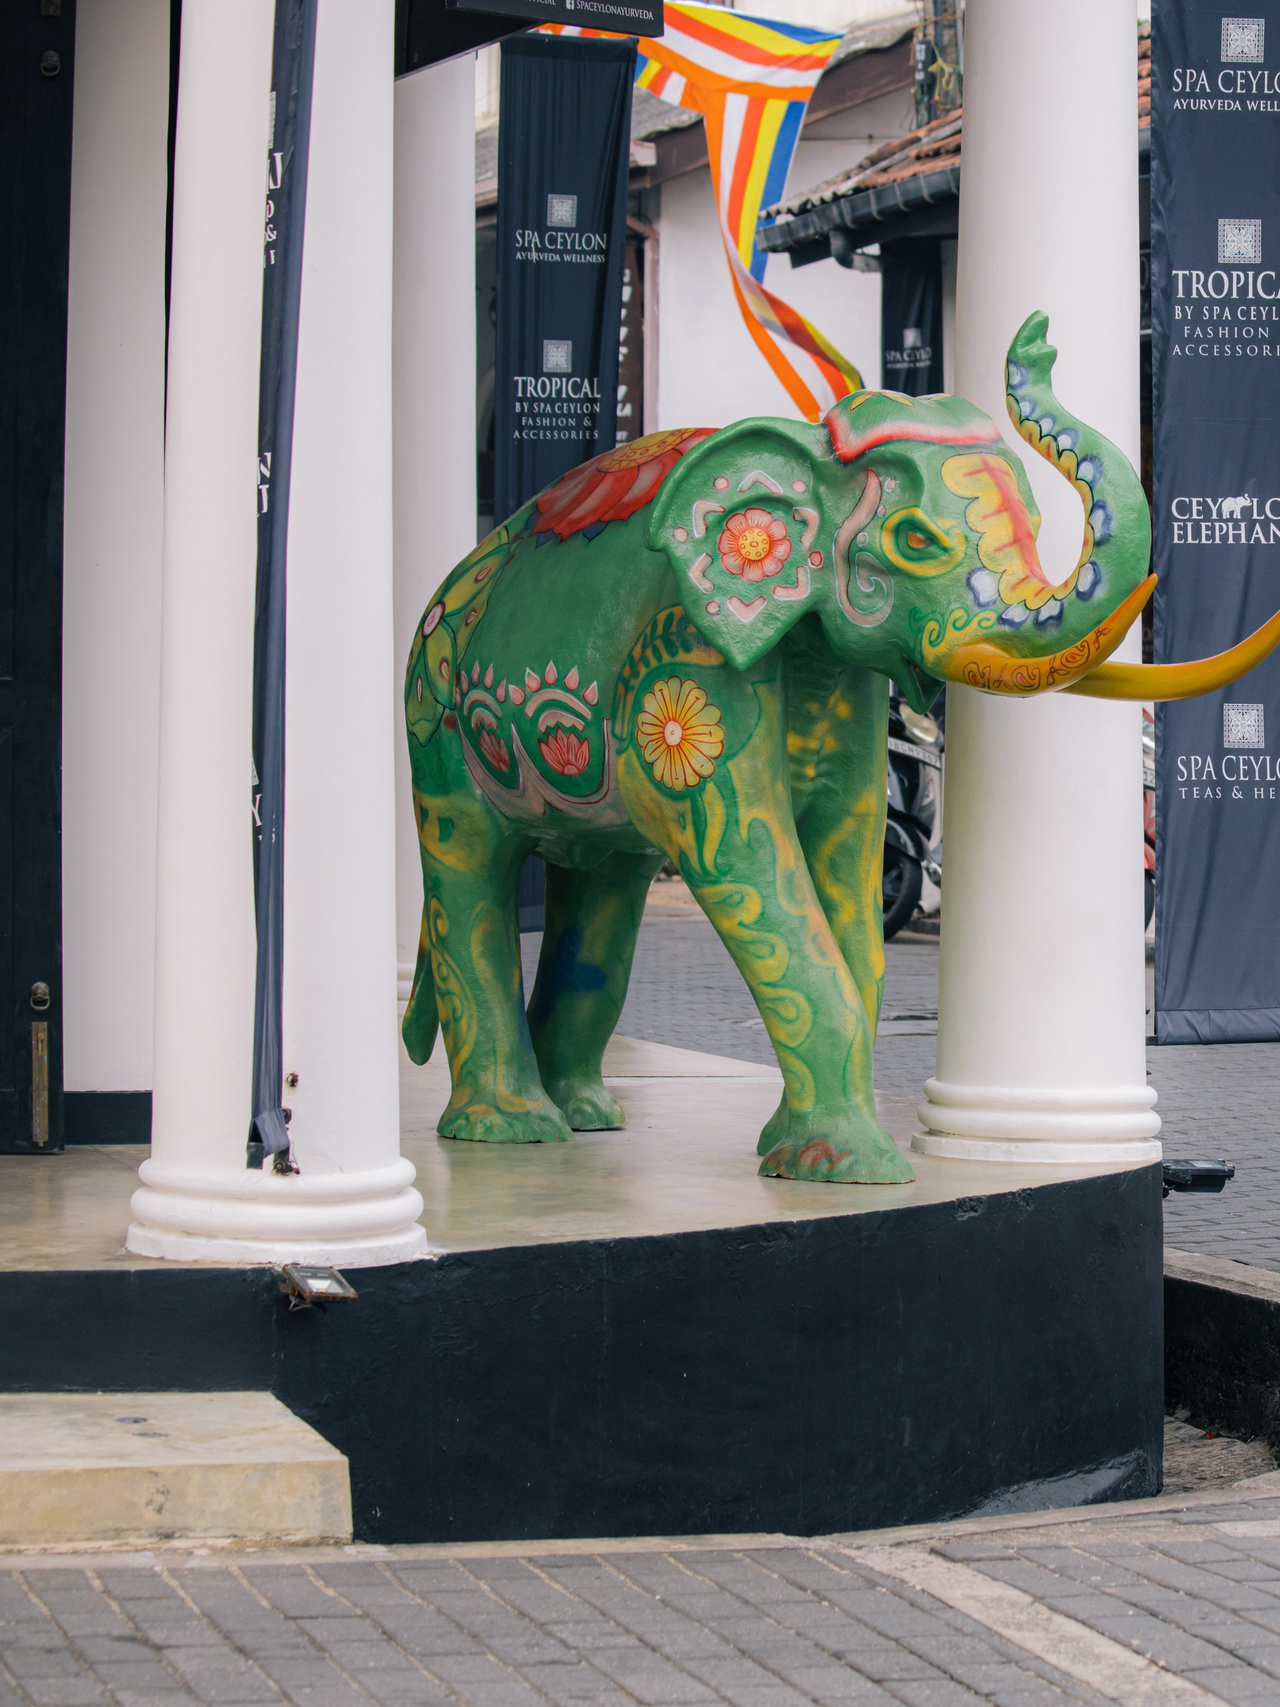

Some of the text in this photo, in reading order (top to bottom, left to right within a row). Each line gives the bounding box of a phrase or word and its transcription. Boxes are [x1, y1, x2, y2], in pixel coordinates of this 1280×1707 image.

[576, 0, 654, 20] SPACEYLONAYURVEDA
[1172, 68, 1212, 93] SPA
[1173, 98, 1242, 112] AYURVEDA
[515, 229, 607, 250] SPA CEYLON
[516, 252, 606, 263] AYURVEDA WELLNESS
[1174, 305, 1194, 320] BY
[1203, 306, 1232, 321] SPA
[1184, 326, 1270, 339] FASHION
[514, 376, 601, 398] TROPICAL
[515, 402, 600, 414] BY SPA CEYLON
[522, 417, 592, 426] FASHION &
[513, 430, 599, 439] ACCESSORIES
[1177, 755, 1217, 781] SPA
[1179, 787, 1222, 799] TEAS
[1231, 786, 1244, 799] &
